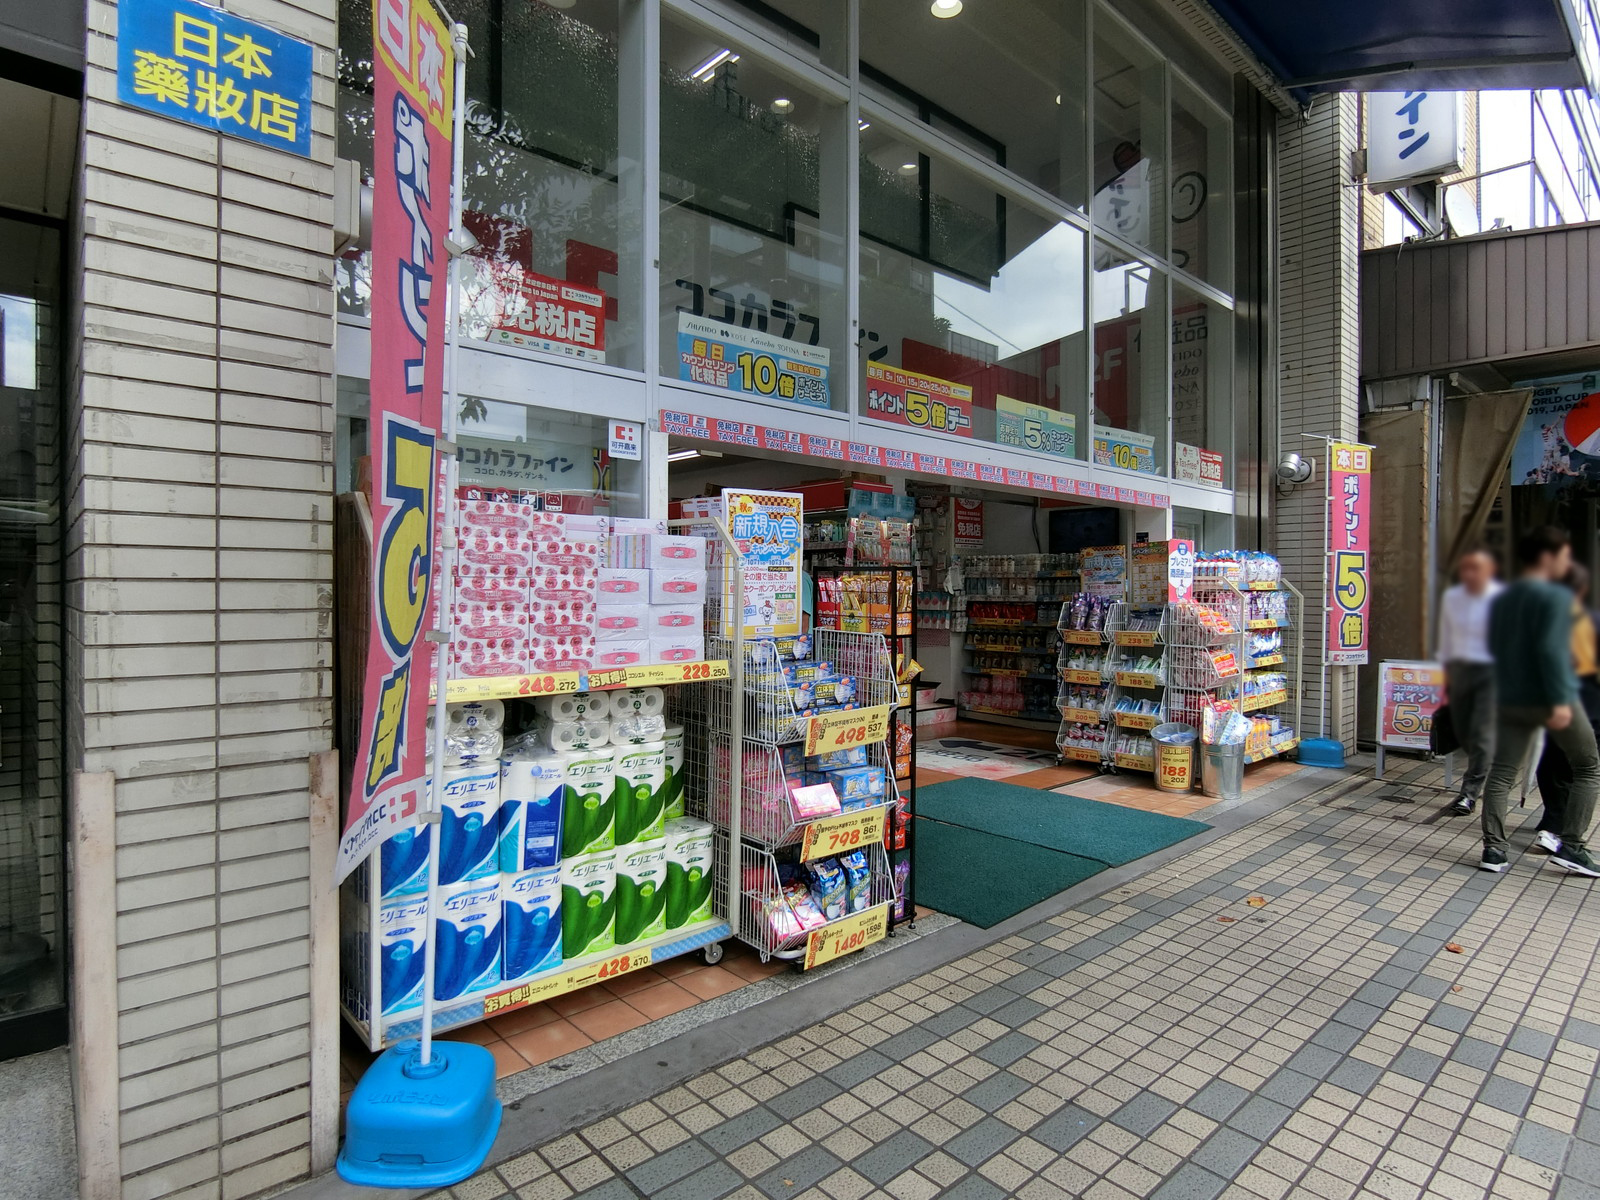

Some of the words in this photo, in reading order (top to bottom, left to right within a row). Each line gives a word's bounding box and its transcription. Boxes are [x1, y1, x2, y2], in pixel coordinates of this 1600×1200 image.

[173, 13, 274, 80] 日本
[133, 50, 300, 142] 藥妝店
[1395, 91, 1430, 160] イン
[501, 279, 532, 294] Welome
[533, 288, 540, 296] to
[540, 290, 559, 301] Japan
[502, 301, 596, 346] 免税店
[686, 322, 717, 335] SHISEIDO
[751, 337, 776, 350] Kanebo
[778, 344, 800, 356] SOFINA
[693, 339, 724, 361] 毎日
[681, 352, 737, 374] カウンセリング
[690, 366, 729, 388] 化粧品
[738, 352, 796, 399] 10倍
[798, 377, 826, 392] ポイント
[798, 388, 828, 404] サービス!
[1532, 387, 1560, 397] GBY
[1532, 394, 1562, 406] ORLD
[1564, 392, 1590, 402] CUP
[1550, 402, 1589, 413] JAPAN
[665, 412, 689, 425] 免税店
[665, 424, 683, 436] TAX
[685, 426, 710, 440] FREE
[718, 420, 739, 433] 免税店
[718, 432, 735, 443] TAX
[736, 434, 758, 446] FREE
[765, 429, 786, 442] 免税店
[809, 436, 828, 448] 免税店
[1024, 419, 1052, 452] 5%
[766, 440, 781, 450] TAX
[782, 442, 803, 453] FREE
[810, 447, 823, 457] TAX
[824, 448, 844, 459] FREE
[849, 444, 866, 454] 免税店
[850, 454, 862, 464] TAX
[864, 454, 881, 465] FREE
[886, 460, 898, 468] TAX
[899, 460, 915, 470] FREE
[1336, 448, 1368, 471] 本日
[474, 467, 548, 482] ココロ、カラダ、ゲンキ。
[920, 464, 931, 473] TAX
[932, 465, 947, 475] FREE
[952, 469, 963, 478] TAX
[963, 470, 977, 479] FREE
[1182, 469, 1194, 480] Shop
[740, 502, 753, 513] 秋の
[735, 513, 798, 544] 新規入会
[752, 542, 790, 555] キャンペーン
[683, 664, 711, 680] 228
[713, 668, 727, 677] 250
[1402, 672, 1430, 682] 本日
[518, 676, 556, 694] 248
[560, 681, 576, 691] 272
[1393, 691, 1440, 704] ポイント
[868, 722, 883, 733] 537
[835, 726, 866, 745] 498
[623, 756, 664, 769] エリエール
[570, 764, 613, 777] エリエール
[1163, 765, 1187, 777] 188
[447, 781, 497, 796] エリエール
[863, 825, 877, 835] 861
[829, 829, 860, 850] 798
[678, 840, 712, 854] エリエール
[486, 860, 494, 868] 12
[628, 853, 666, 867] エリエール
[574, 862, 615, 878] エリエール
[417, 873, 427, 883] 12
[515, 874, 560, 893] エリエール
[448, 893, 498, 911] エリエール
[598, 956, 631, 978] 428
[633, 956, 649, 968] 470
[487, 971, 496, 980] 12
[416, 988, 423, 998] 12
